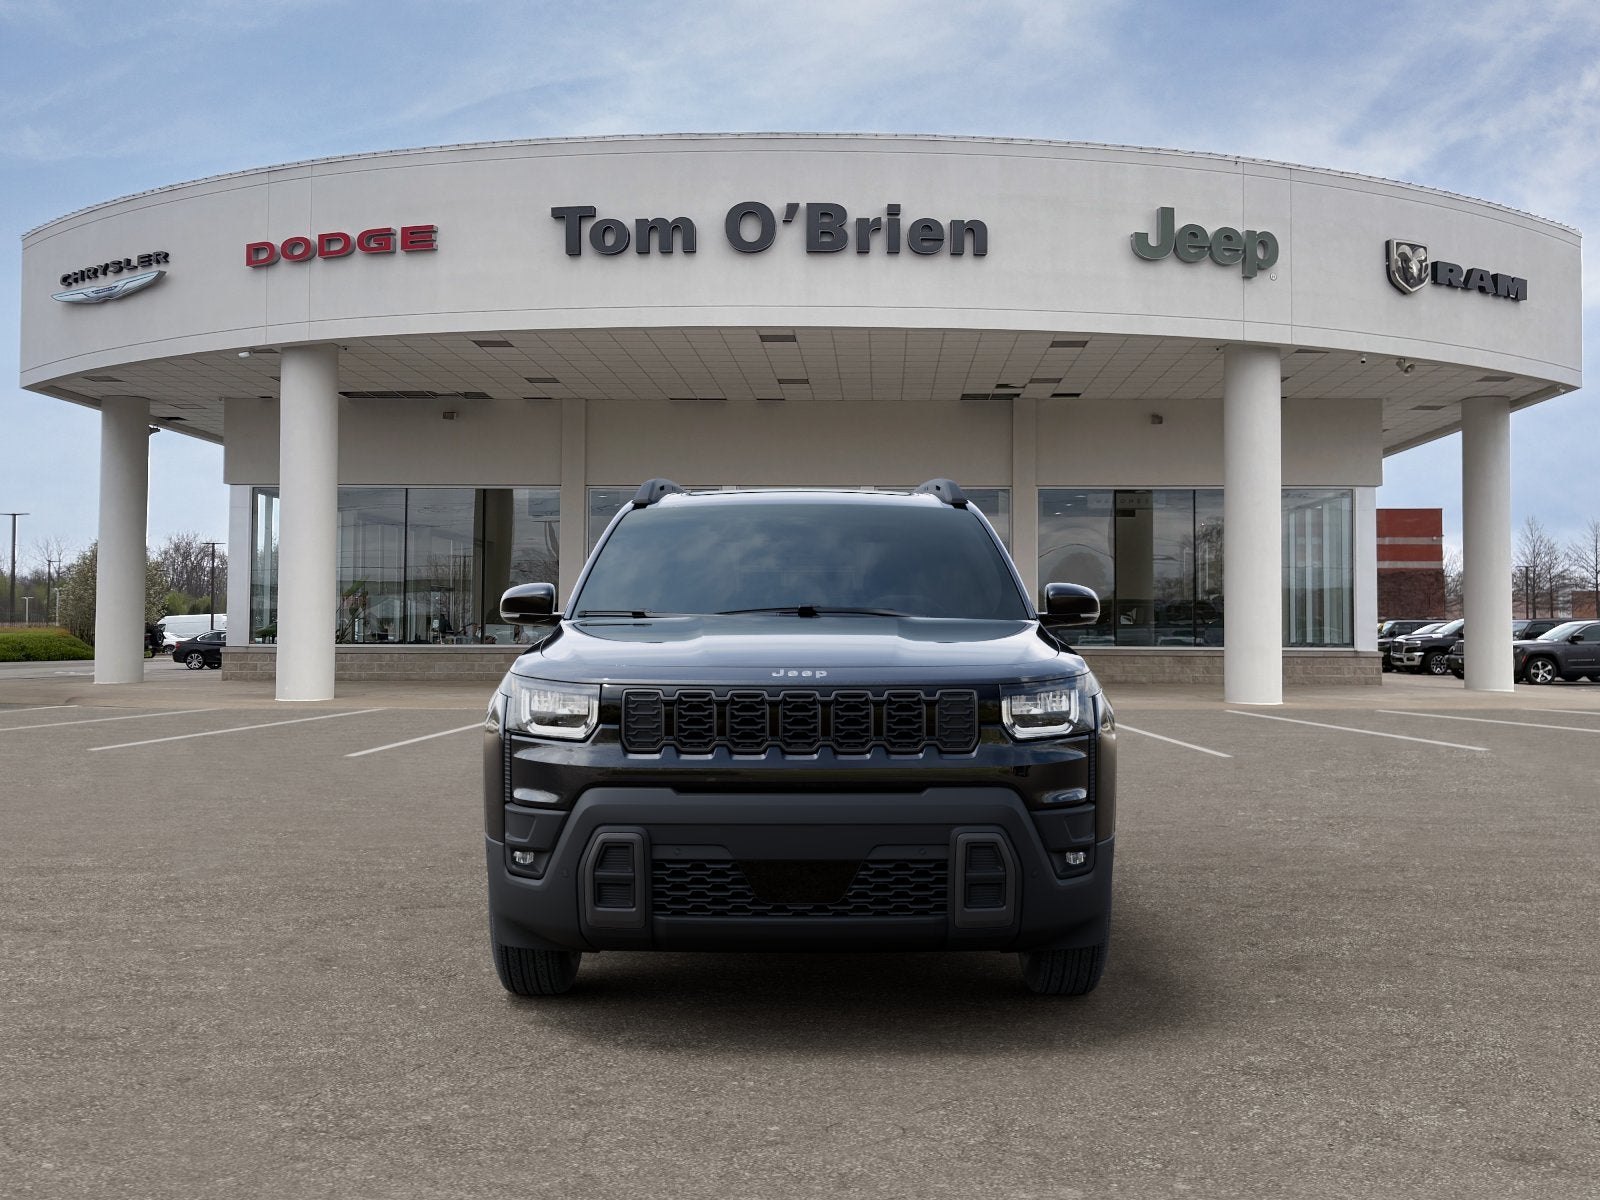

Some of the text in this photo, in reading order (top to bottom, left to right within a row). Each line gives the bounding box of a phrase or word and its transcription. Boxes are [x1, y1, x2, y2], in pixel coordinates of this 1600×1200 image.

[245, 225, 438, 268] DODGE
[551, 201, 988, 256] Tom O'Brien
[1131, 207, 1279, 278] Jeep
[60, 251, 170, 287] CHRYSLER
[1431, 261, 1528, 301] RAM
[771, 669, 828, 679] Jeep
